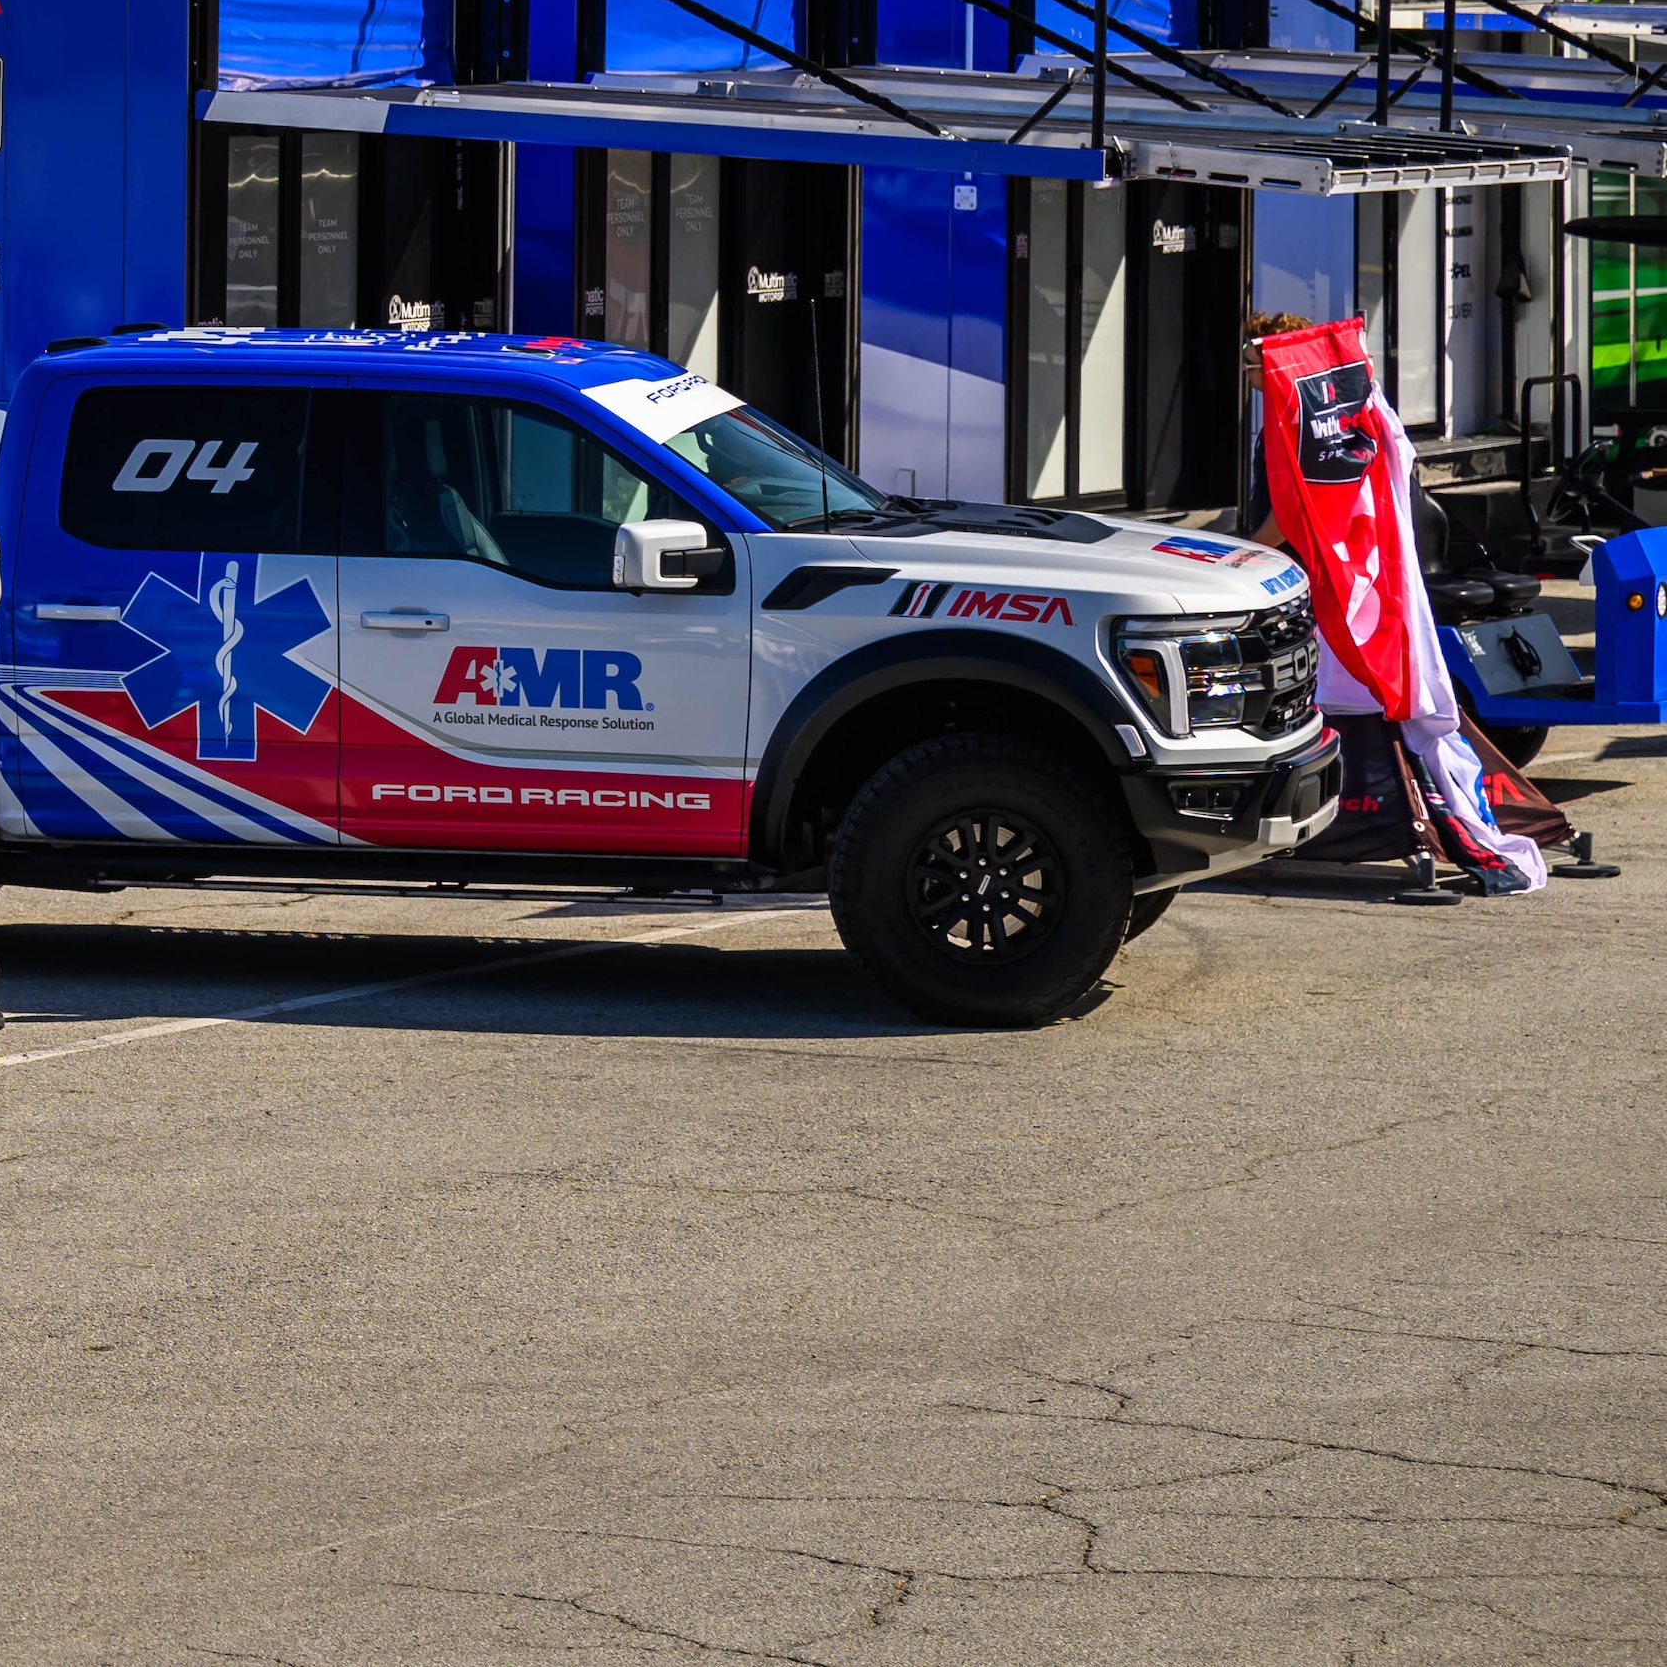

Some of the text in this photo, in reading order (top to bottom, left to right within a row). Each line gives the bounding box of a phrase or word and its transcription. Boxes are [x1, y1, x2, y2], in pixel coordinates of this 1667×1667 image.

[616, 197, 635, 210] TEAM
[685, 194, 704, 205] TEAM
[607, 212, 646, 224] PERSONNEL
[675, 207, 714, 219] PERSONNEL
[238, 223, 259, 232] TEAM
[318, 219, 338, 228] TEAM
[685, 221, 703, 233] ONLY
[308, 230, 349, 242] PERSONNEL
[617, 225, 635, 237] ONLY
[229, 235, 270, 246] PERSONNEL
[238, 249, 259, 260] ONLY
[317, 244, 337, 255] ONLY
[112, 438, 260, 494] 04
[946, 589, 1075, 627] IMSA
[432, 645, 644, 712] AMR
[433, 712, 655, 731] A Global Medical Response Solution
[372, 783, 711, 811] FORD RACING
